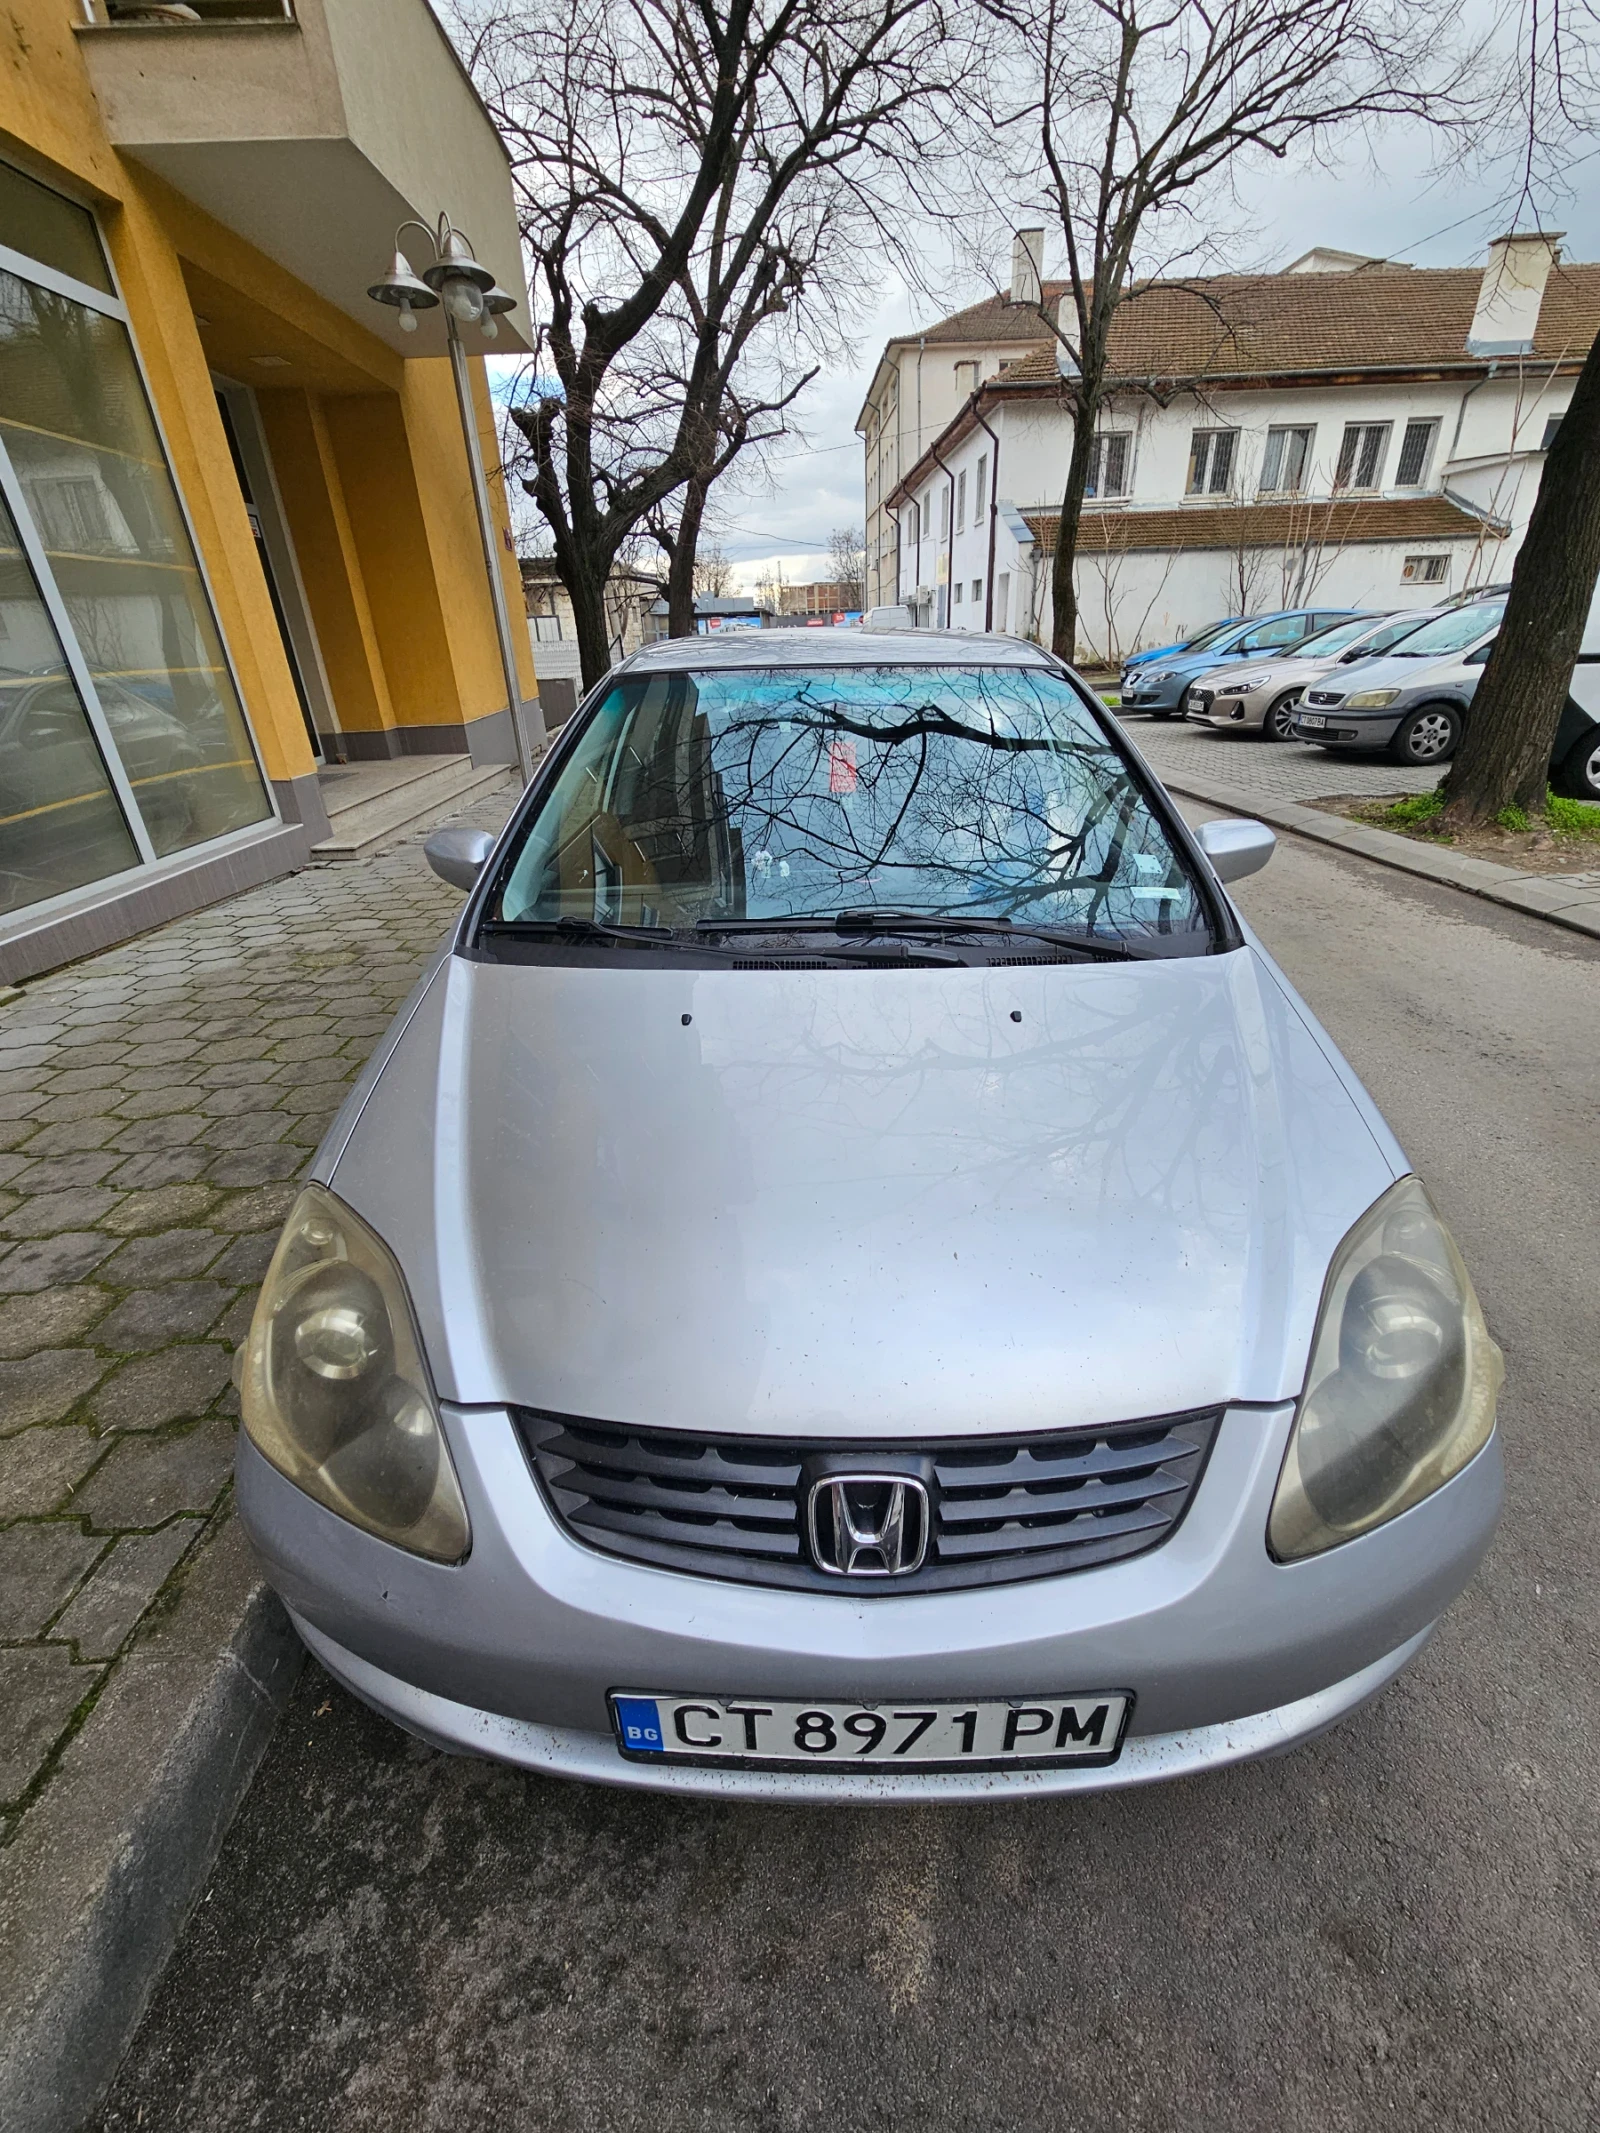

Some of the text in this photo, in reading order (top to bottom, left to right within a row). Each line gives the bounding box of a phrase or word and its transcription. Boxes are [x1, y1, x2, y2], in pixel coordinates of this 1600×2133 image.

[627, 1726, 658, 1741] BG
[674, 1704, 1110, 1754] CT 8971 PM
